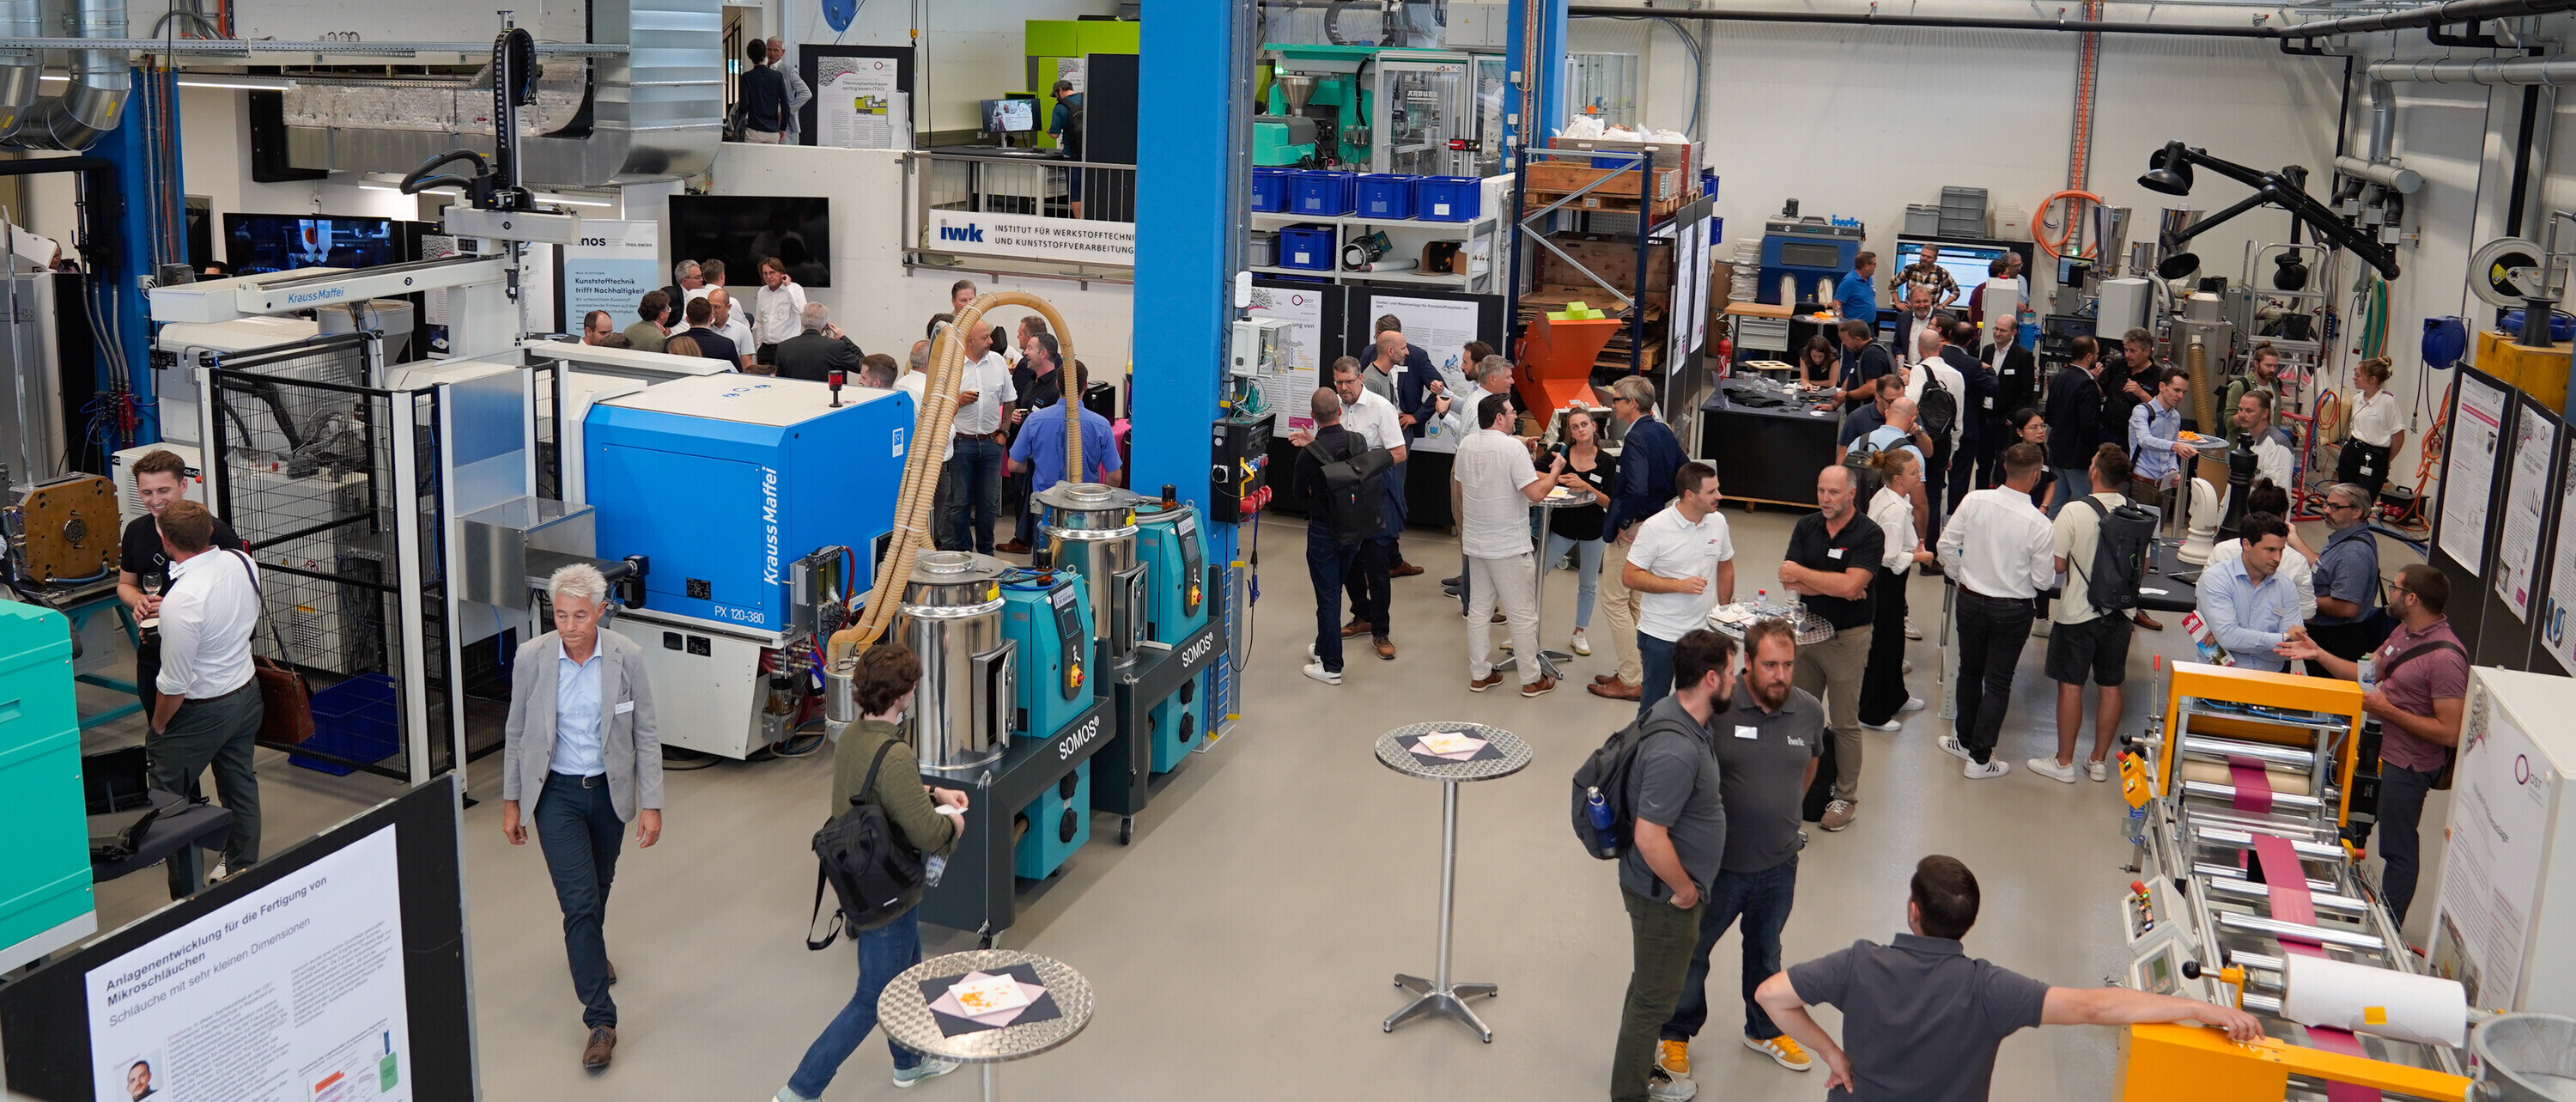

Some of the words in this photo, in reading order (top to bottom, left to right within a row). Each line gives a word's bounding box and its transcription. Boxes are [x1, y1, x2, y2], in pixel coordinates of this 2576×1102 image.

[941, 218, 984, 242] iwk
[1832, 215, 1859, 228] iwk
[578, 237, 606, 246] nos
[994, 225, 1032, 234] INSTITUT
[1035, 226, 1050, 235] FÜR
[1053, 228, 1134, 241] WERKSTOFFTECHNI
[994, 237, 1013, 246] UND
[1016, 239, 1134, 254] KUNSTSTOFFVERARBEITUNG
[714, 605, 727, 618] PX
[730, 608, 764, 624] 120-380
[2530, 773, 2542, 790] OST
[106, 928, 222, 992] Anlagenentwicklung
[224, 919, 240, 935] für
[242, 910, 258, 927] die
[260, 885, 307, 916] Fertigung
[309, 876, 328, 892] von
[107, 952, 206, 1008] Mikroschläuchen
[109, 989, 167, 1028] Schläuche
[170, 981, 186, 998] mit
[189, 969, 211, 988] sehr
[213, 950, 249, 976] kleinen
[251, 917, 311, 955] Dimensionen
